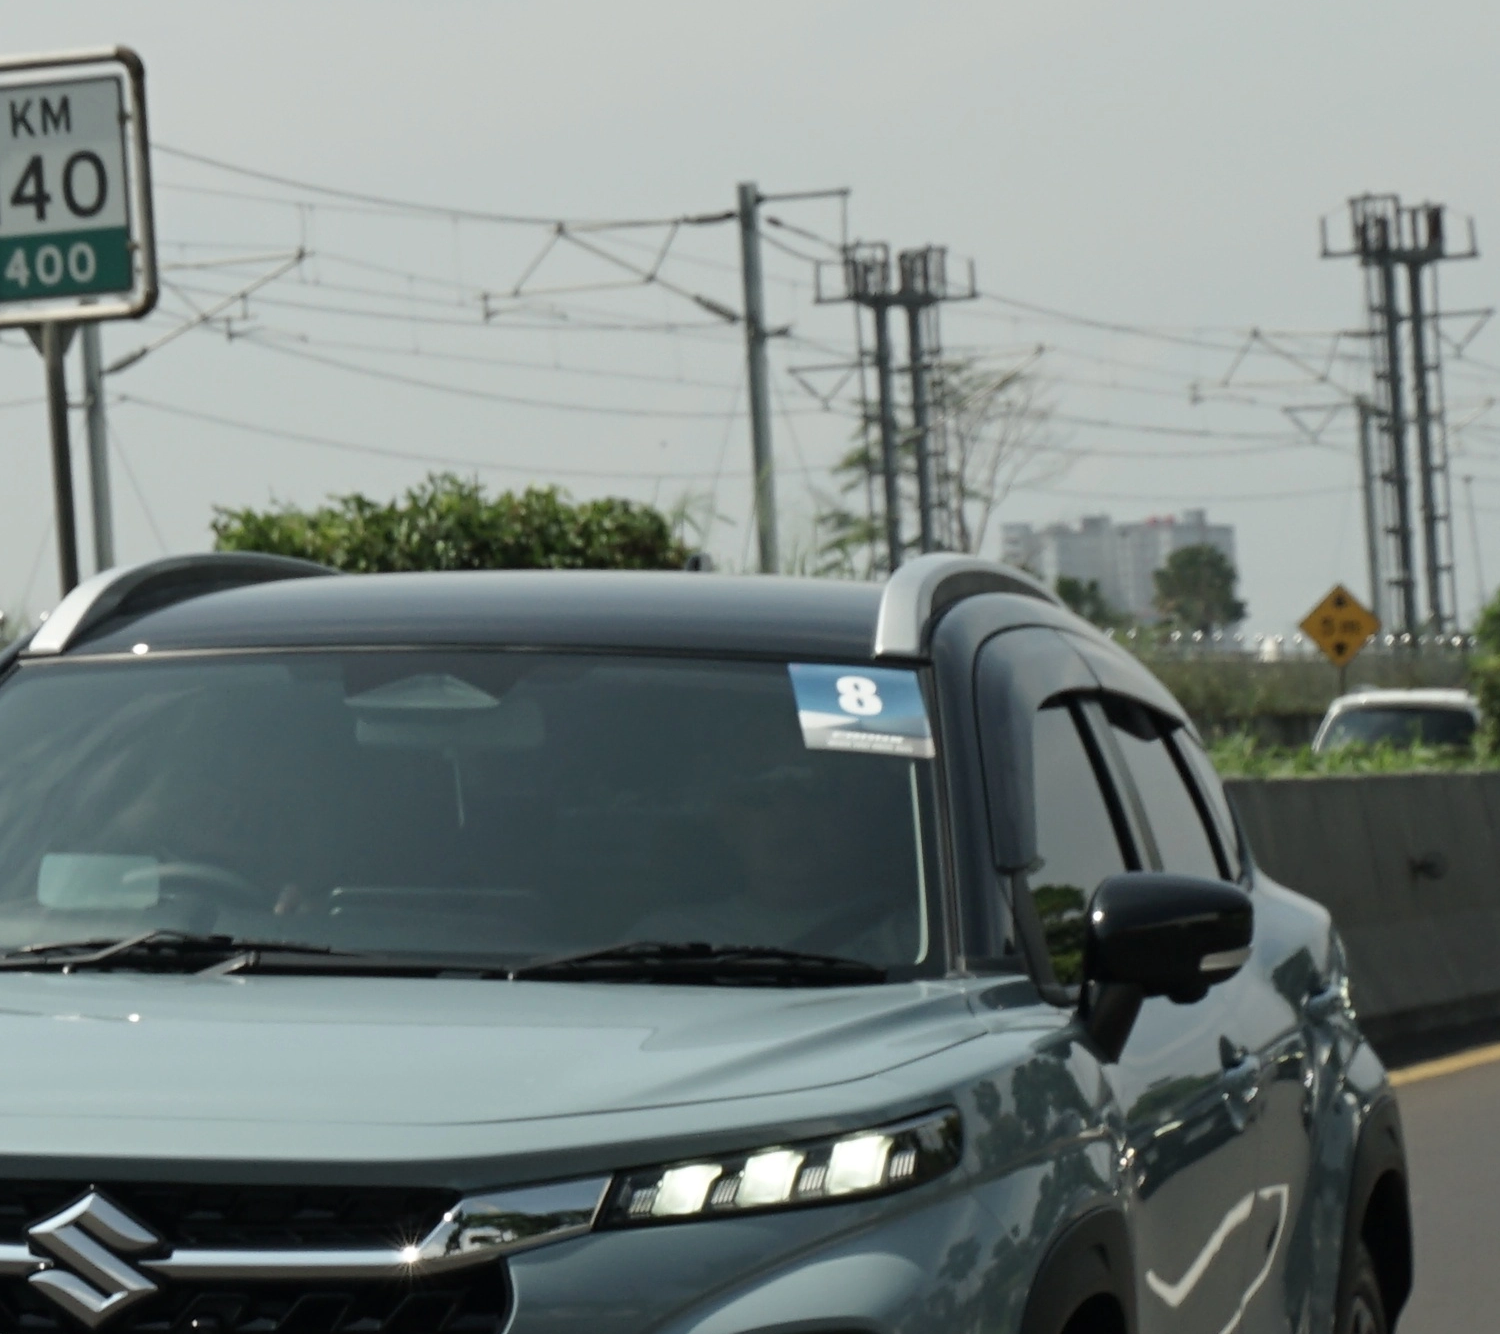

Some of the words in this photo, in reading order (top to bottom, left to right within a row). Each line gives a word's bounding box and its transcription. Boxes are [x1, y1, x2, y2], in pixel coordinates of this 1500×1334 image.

[8, 95, 71, 138] KM
[4, 241, 97, 288] 400
[836, 675, 883, 716] 8
